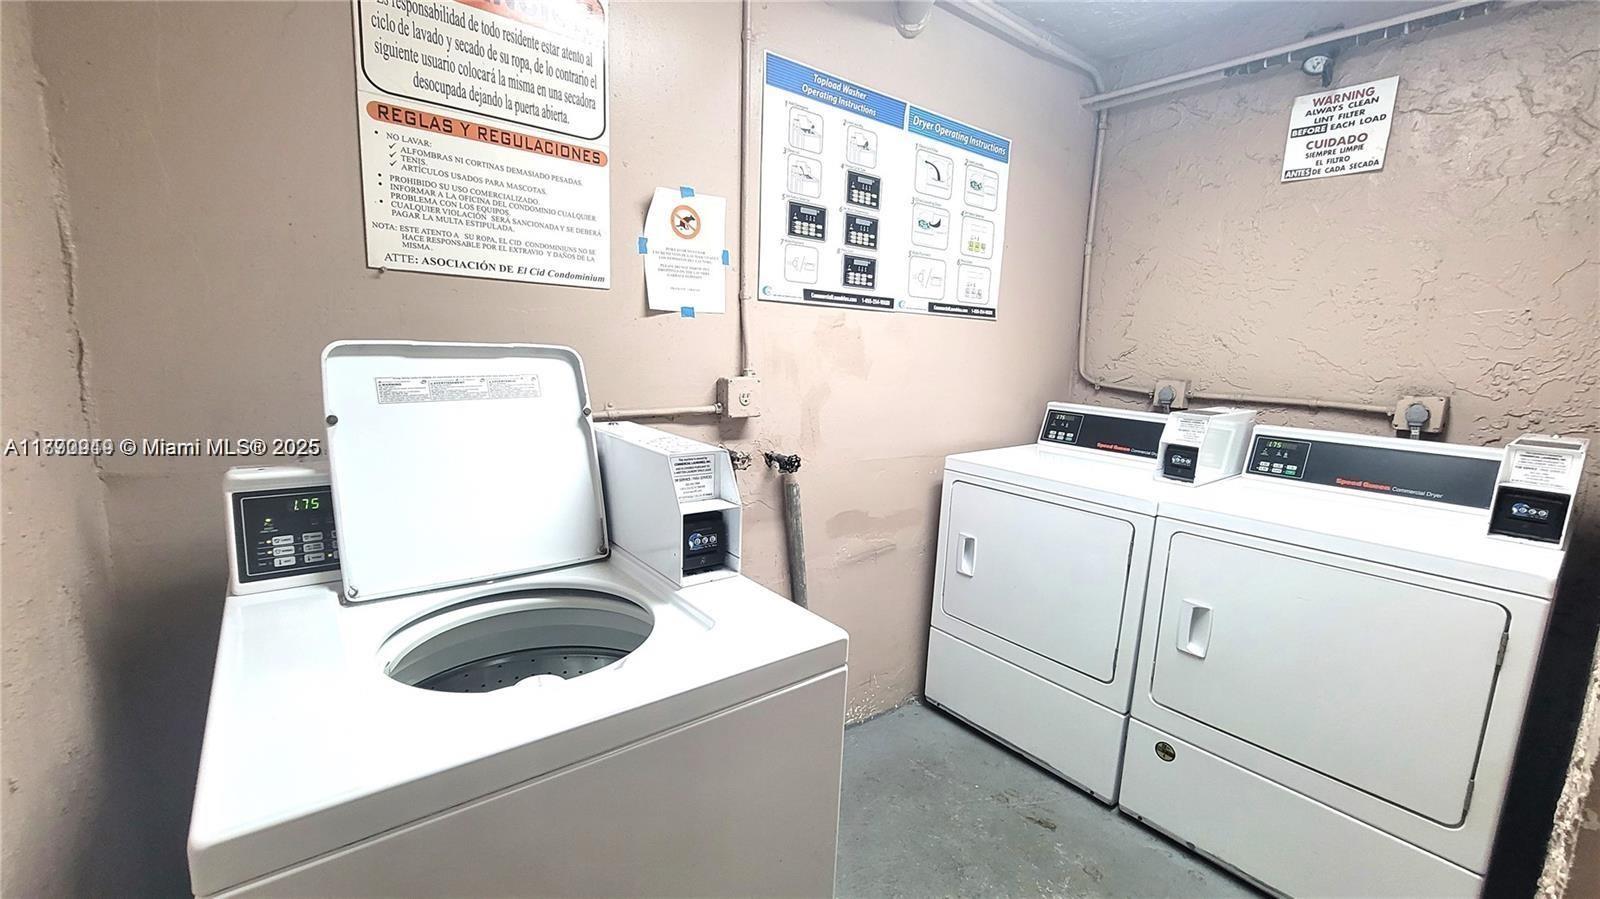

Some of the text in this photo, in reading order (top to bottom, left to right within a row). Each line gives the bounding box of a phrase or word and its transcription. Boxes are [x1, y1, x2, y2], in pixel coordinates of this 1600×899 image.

[371, 11, 597, 89] ciclo de lavado y secado de su ropa, de lo contrario el
[468, 14, 478, 32] de
[481, 20, 500, 38] todo
[502, 28, 539, 50] residente
[541, 41, 560, 56] estar
[562, 47, 584, 64] atento
[586, 52, 592, 66] al
[375, 37, 596, 109] siguiente usuario colocará la misma en una secadora
[813, 74, 867, 100] Topload Washer
[1312, 87, 1376, 107] WARNING
[413, 71, 570, 124] desocupada dejando la puerta abierta.
[802, 84, 876, 116] Operating Instructions
[1305, 96, 1380, 117] ALWAYS CLEAN
[1292, 114, 1387, 137] BEFORE EACH LOAD
[1314, 109, 1366, 124] LINT FILTER
[378, 104, 600, 164] REGLAS Y REGULACIONES
[386, 132, 432, 148] NO LAVAR:
[913, 116, 1006, 155] Dryer Operating Instructions
[1306, 133, 1368, 150] CUIDADO
[401, 155, 428, 166] TENIS.
[1305, 144, 1364, 159] SIEMPRE LIMPIE
[1326, 156, 1350, 164] FILTRO
[400, 146, 453, 162] ALFOMBRAS
[454, 156, 463, 164] NI
[465, 159, 504, 172] CORTINAS
[506, 166, 550, 180] DEMASIADO
[1285, 169, 1311, 179] ANTES
[1324, 165, 1345, 174] CADA
[1349, 159, 1379, 170] SECADA
[390, 175, 437, 188] PROHIBIDO
[452, 185, 468, 193] USO
[451, 172, 483, 184] USADOS
[485, 179, 504, 188] PARA
[390, 184, 436, 197] INFORMAR
[458, 194, 490, 205] OFICINA
[508, 202, 556, 216] CONDOMINIO
[391, 192, 438, 205] PROBLEMA
[440, 200, 457, 209] CON
[459, 203, 474, 211] LOS
[391, 201, 441, 214] CUALQUIER
[442, 208, 487, 220] VIOLACIÓN
[512, 218, 559, 231] SANCIONADA
[392, 209, 420, 220] PAGAR
[436, 215, 463, 226] MULTA
[372, 221, 398, 231] NOTA:
[399, 225, 419, 234] ESTE
[421, 228, 452, 238] ATENTO
[402, 233, 424, 242] HACE
[426, 236, 480, 249] RESPONSABLE
[384, 253, 605, 282] ATTE: ASOCIACIÓN DE El Cid Condominium
[1392, 486, 1425, 496] Commercial
[1426, 491, 1443, 499] Dryer
